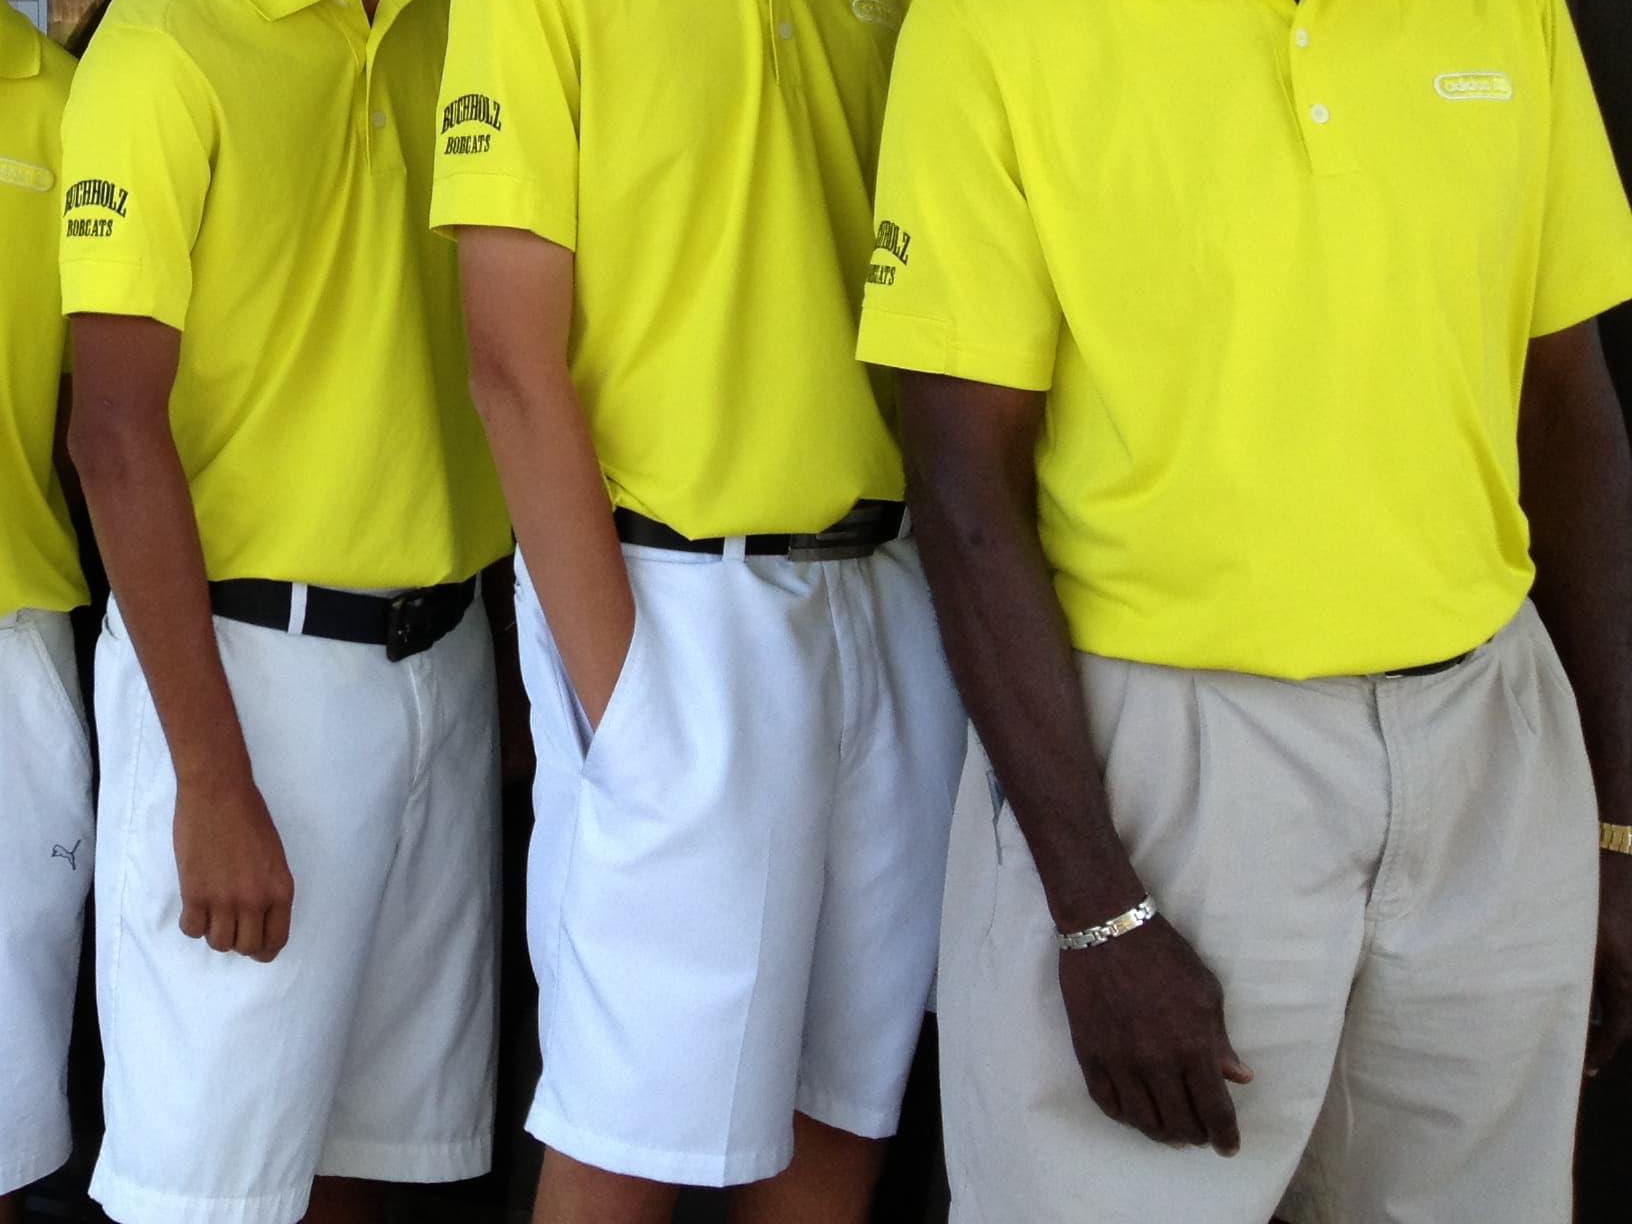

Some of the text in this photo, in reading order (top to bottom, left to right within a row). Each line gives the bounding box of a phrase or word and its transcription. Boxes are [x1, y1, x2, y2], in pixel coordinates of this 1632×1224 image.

[441, 94, 501, 134] BUCHHOLZ
[444, 134, 490, 154] BOBCATS
[67, 219, 113, 237] BOBCATS
